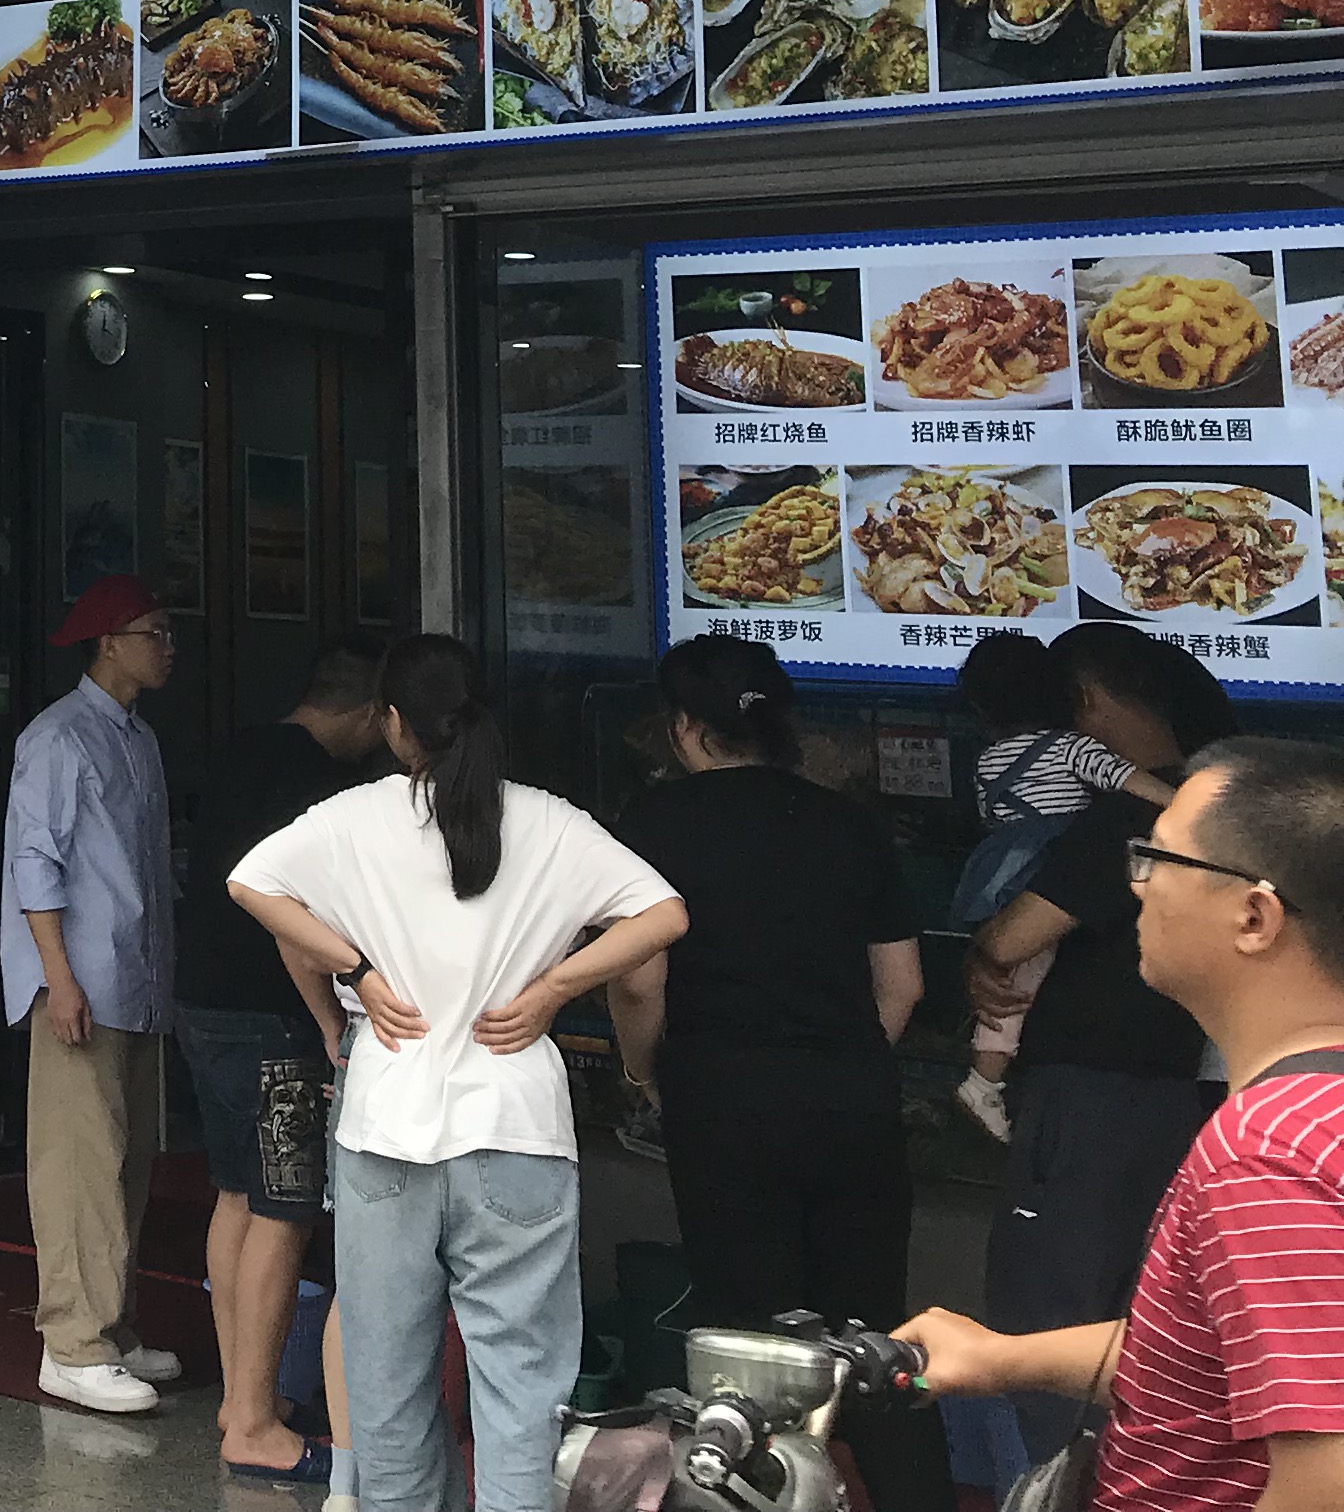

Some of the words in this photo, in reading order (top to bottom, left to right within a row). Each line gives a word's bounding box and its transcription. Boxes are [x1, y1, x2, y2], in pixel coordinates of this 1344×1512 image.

[714, 421, 829, 445] 招牌红烧鱼
[910, 419, 1037, 445] 招牌香辣虾
[1114, 417, 1253, 444] 酥脆鱿鱼圈
[707, 618, 825, 645] 海鲜菠萝饭
[1142, 631, 1272, 661] 牌香辣蟹
